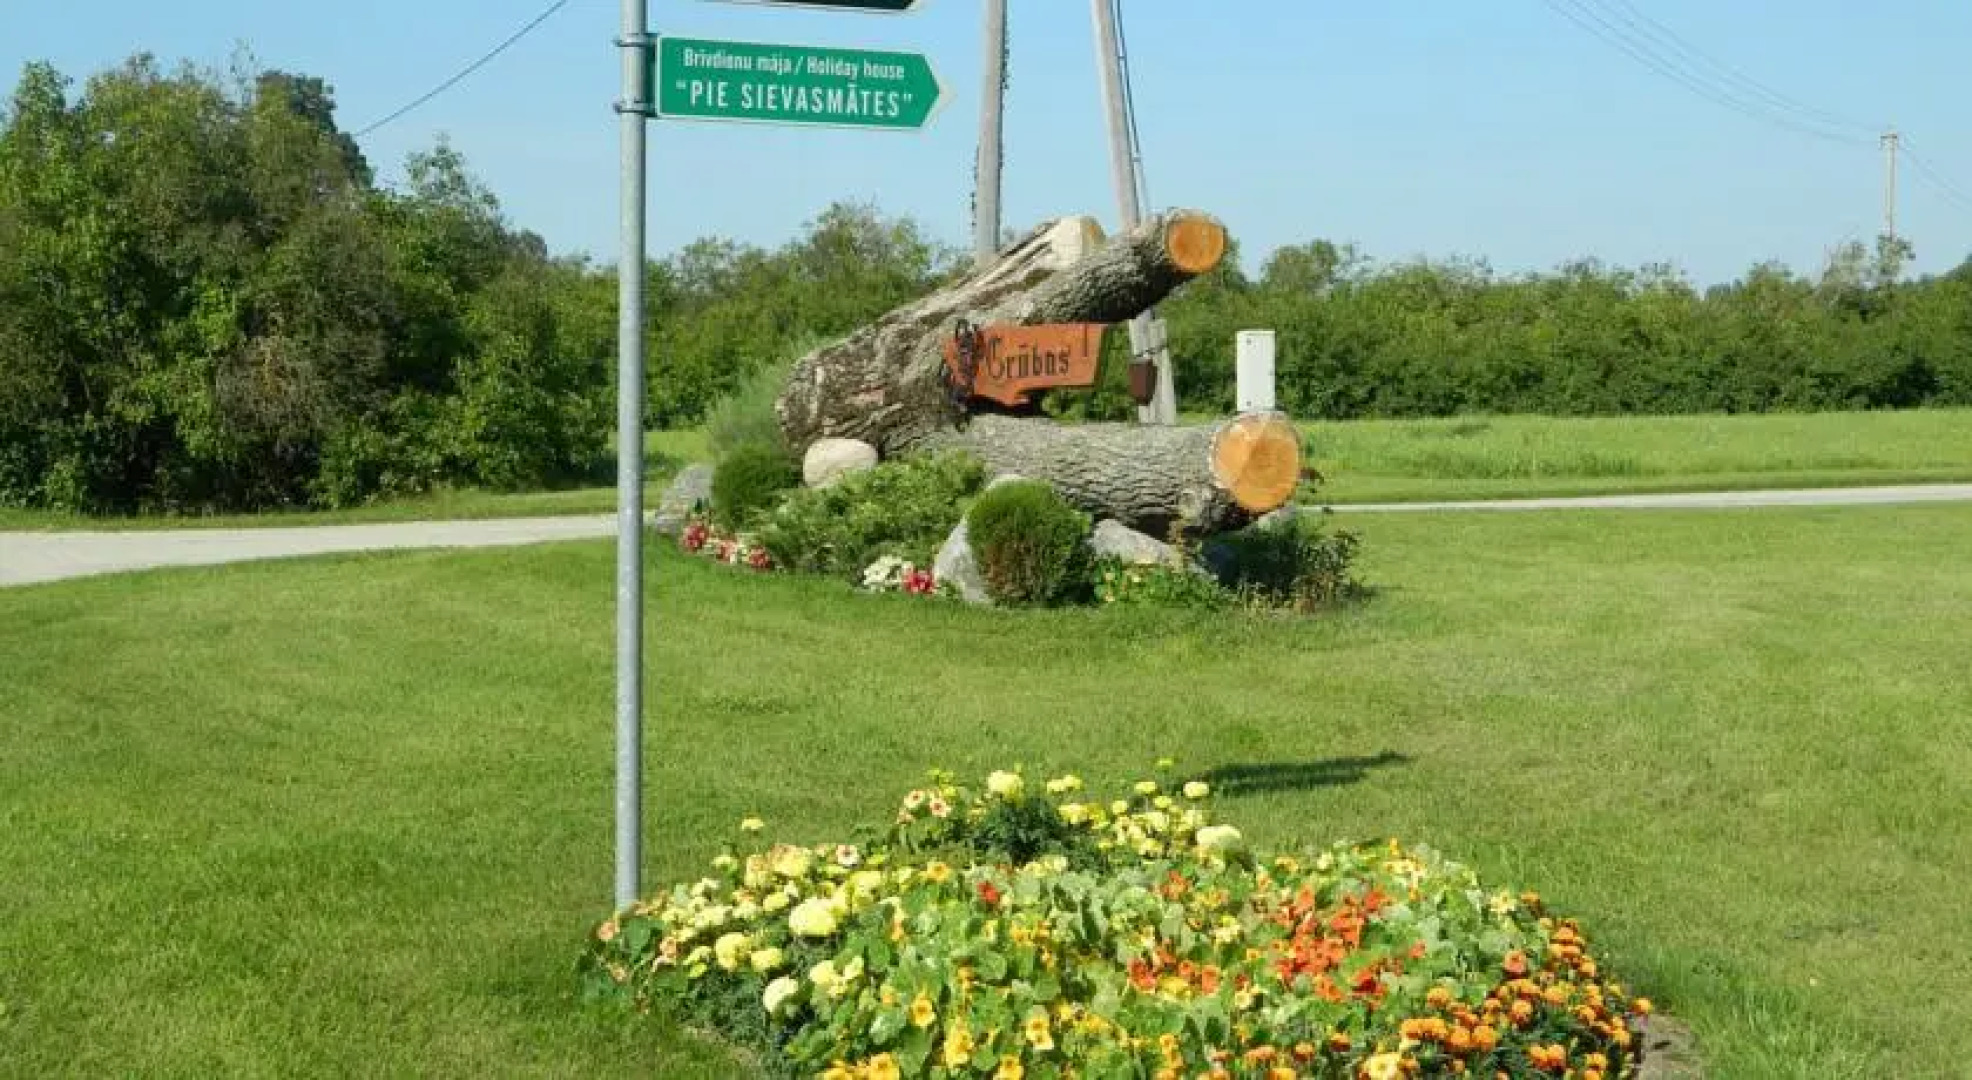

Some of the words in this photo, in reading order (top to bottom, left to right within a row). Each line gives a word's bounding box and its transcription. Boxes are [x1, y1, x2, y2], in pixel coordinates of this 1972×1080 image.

[756, 53, 792, 75] māja
[793, 56, 804, 75] /
[807, 56, 858, 80] Holiday
[863, 58, 905, 80] house
